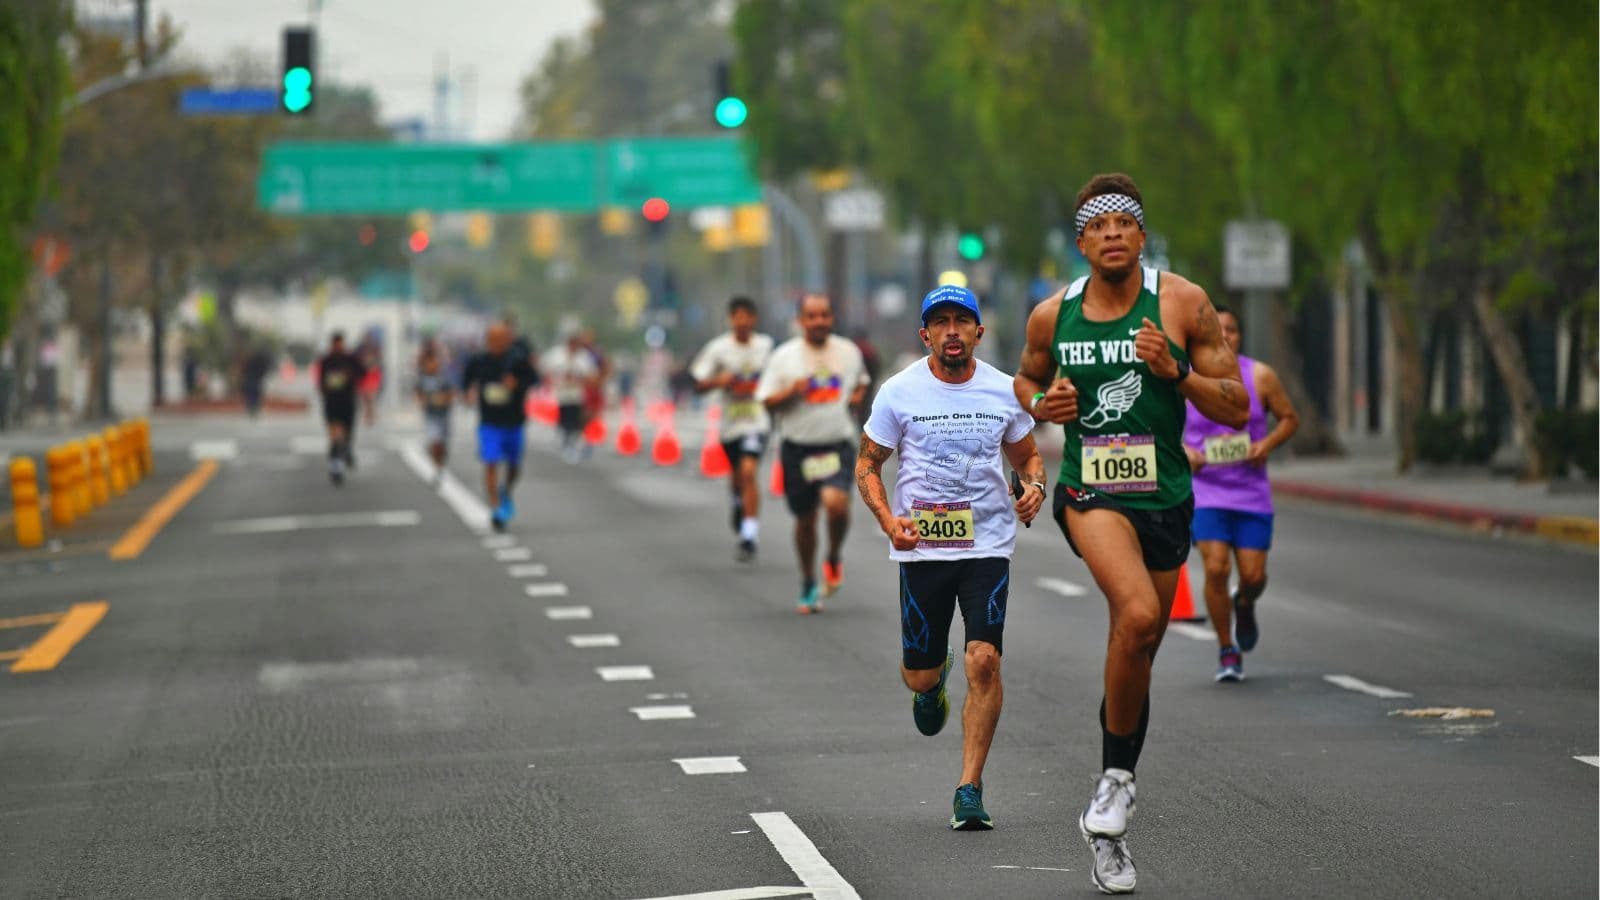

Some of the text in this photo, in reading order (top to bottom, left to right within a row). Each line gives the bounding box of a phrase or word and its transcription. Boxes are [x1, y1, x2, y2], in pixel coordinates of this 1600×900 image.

[1058, 341, 1096, 365] THE
[912, 415, 949, 423] Square
[975, 413, 1004, 423] Dining
[1091, 457, 1148, 480] 1098
[918, 519, 967, 538] 3403
